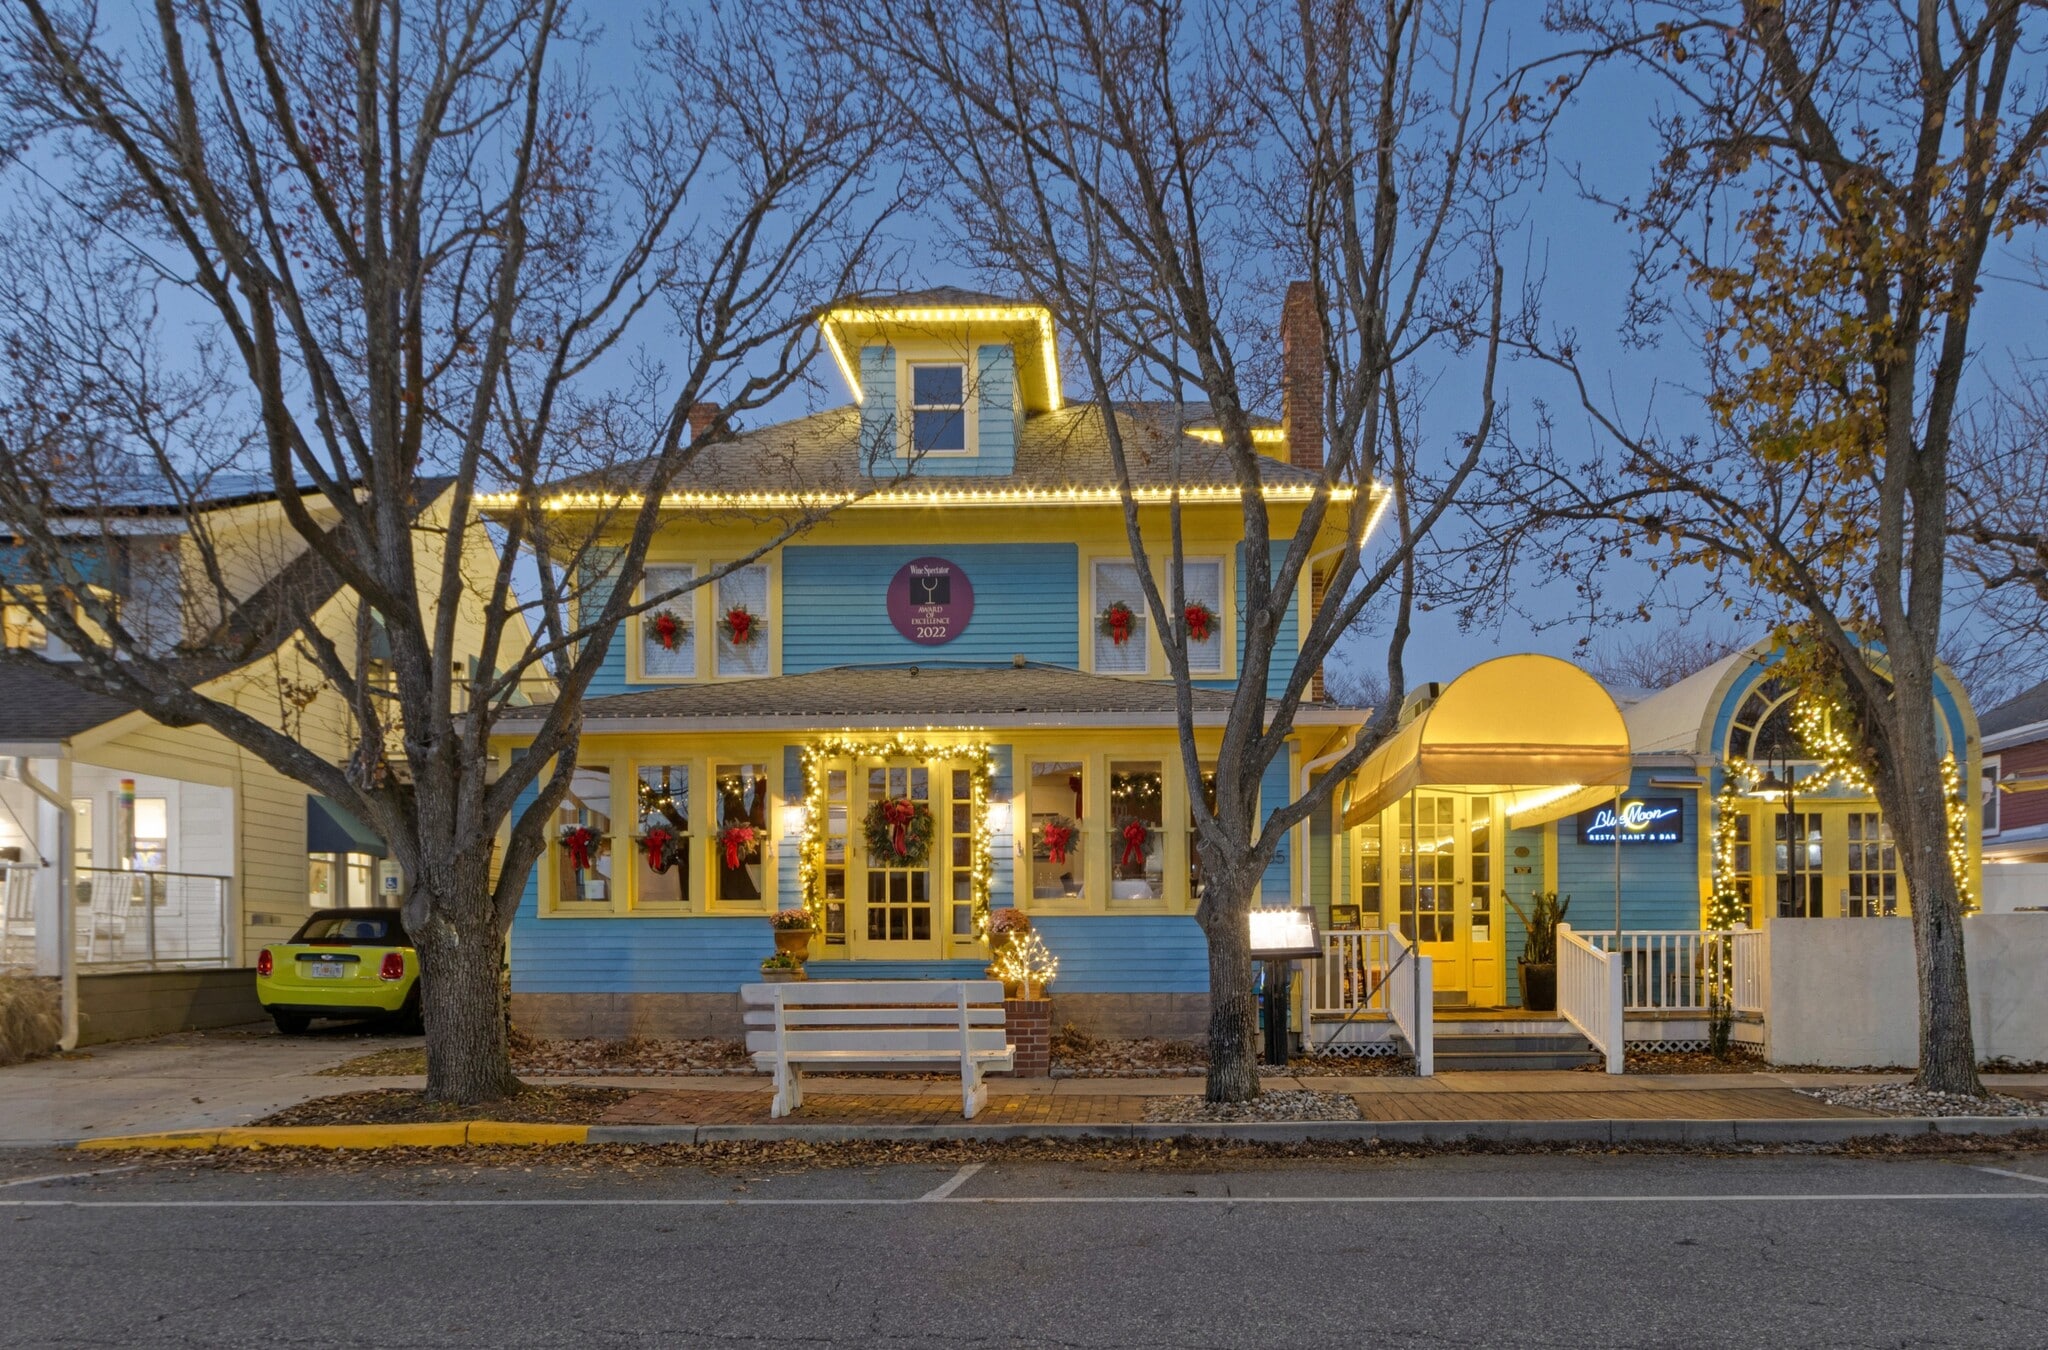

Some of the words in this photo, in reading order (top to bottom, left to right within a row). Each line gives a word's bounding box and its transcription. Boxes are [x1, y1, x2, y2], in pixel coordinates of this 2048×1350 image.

[910, 564, 923, 574] Wine
[923, 565, 950, 576] Spectator
[917, 626, 946, 638] 2022
[1629, 806, 1678, 822] Moon
